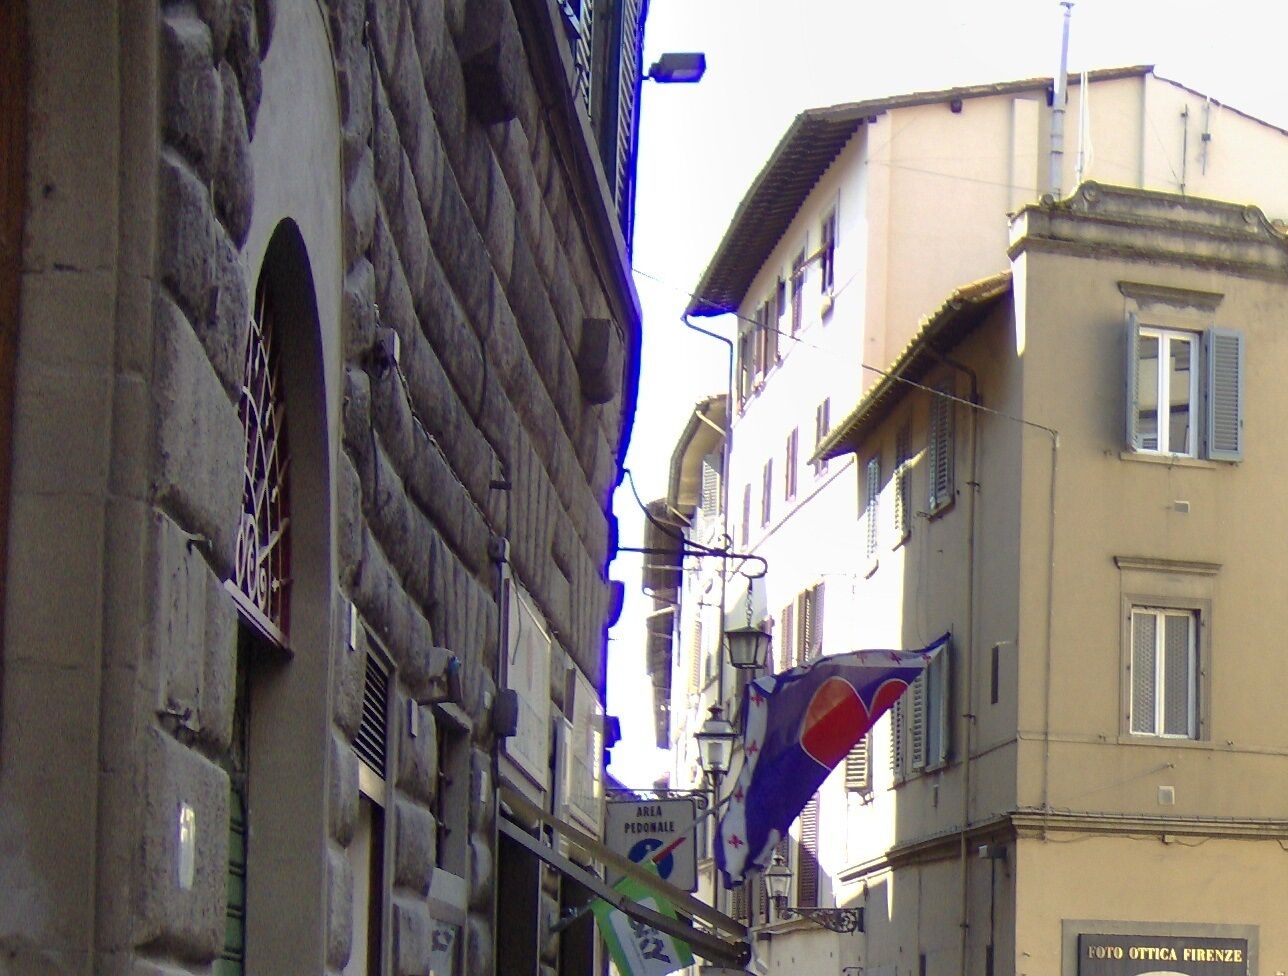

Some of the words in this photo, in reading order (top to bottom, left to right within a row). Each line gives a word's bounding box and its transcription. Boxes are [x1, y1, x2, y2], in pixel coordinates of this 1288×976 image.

[636, 805, 663, 817] AREA
[624, 821, 675, 833] PEDONALE
[1088, 946, 1123, 959] FOTO
[1129, 947, 1177, 961] OTTICA
[1183, 948, 1242, 963] FIRENZE
